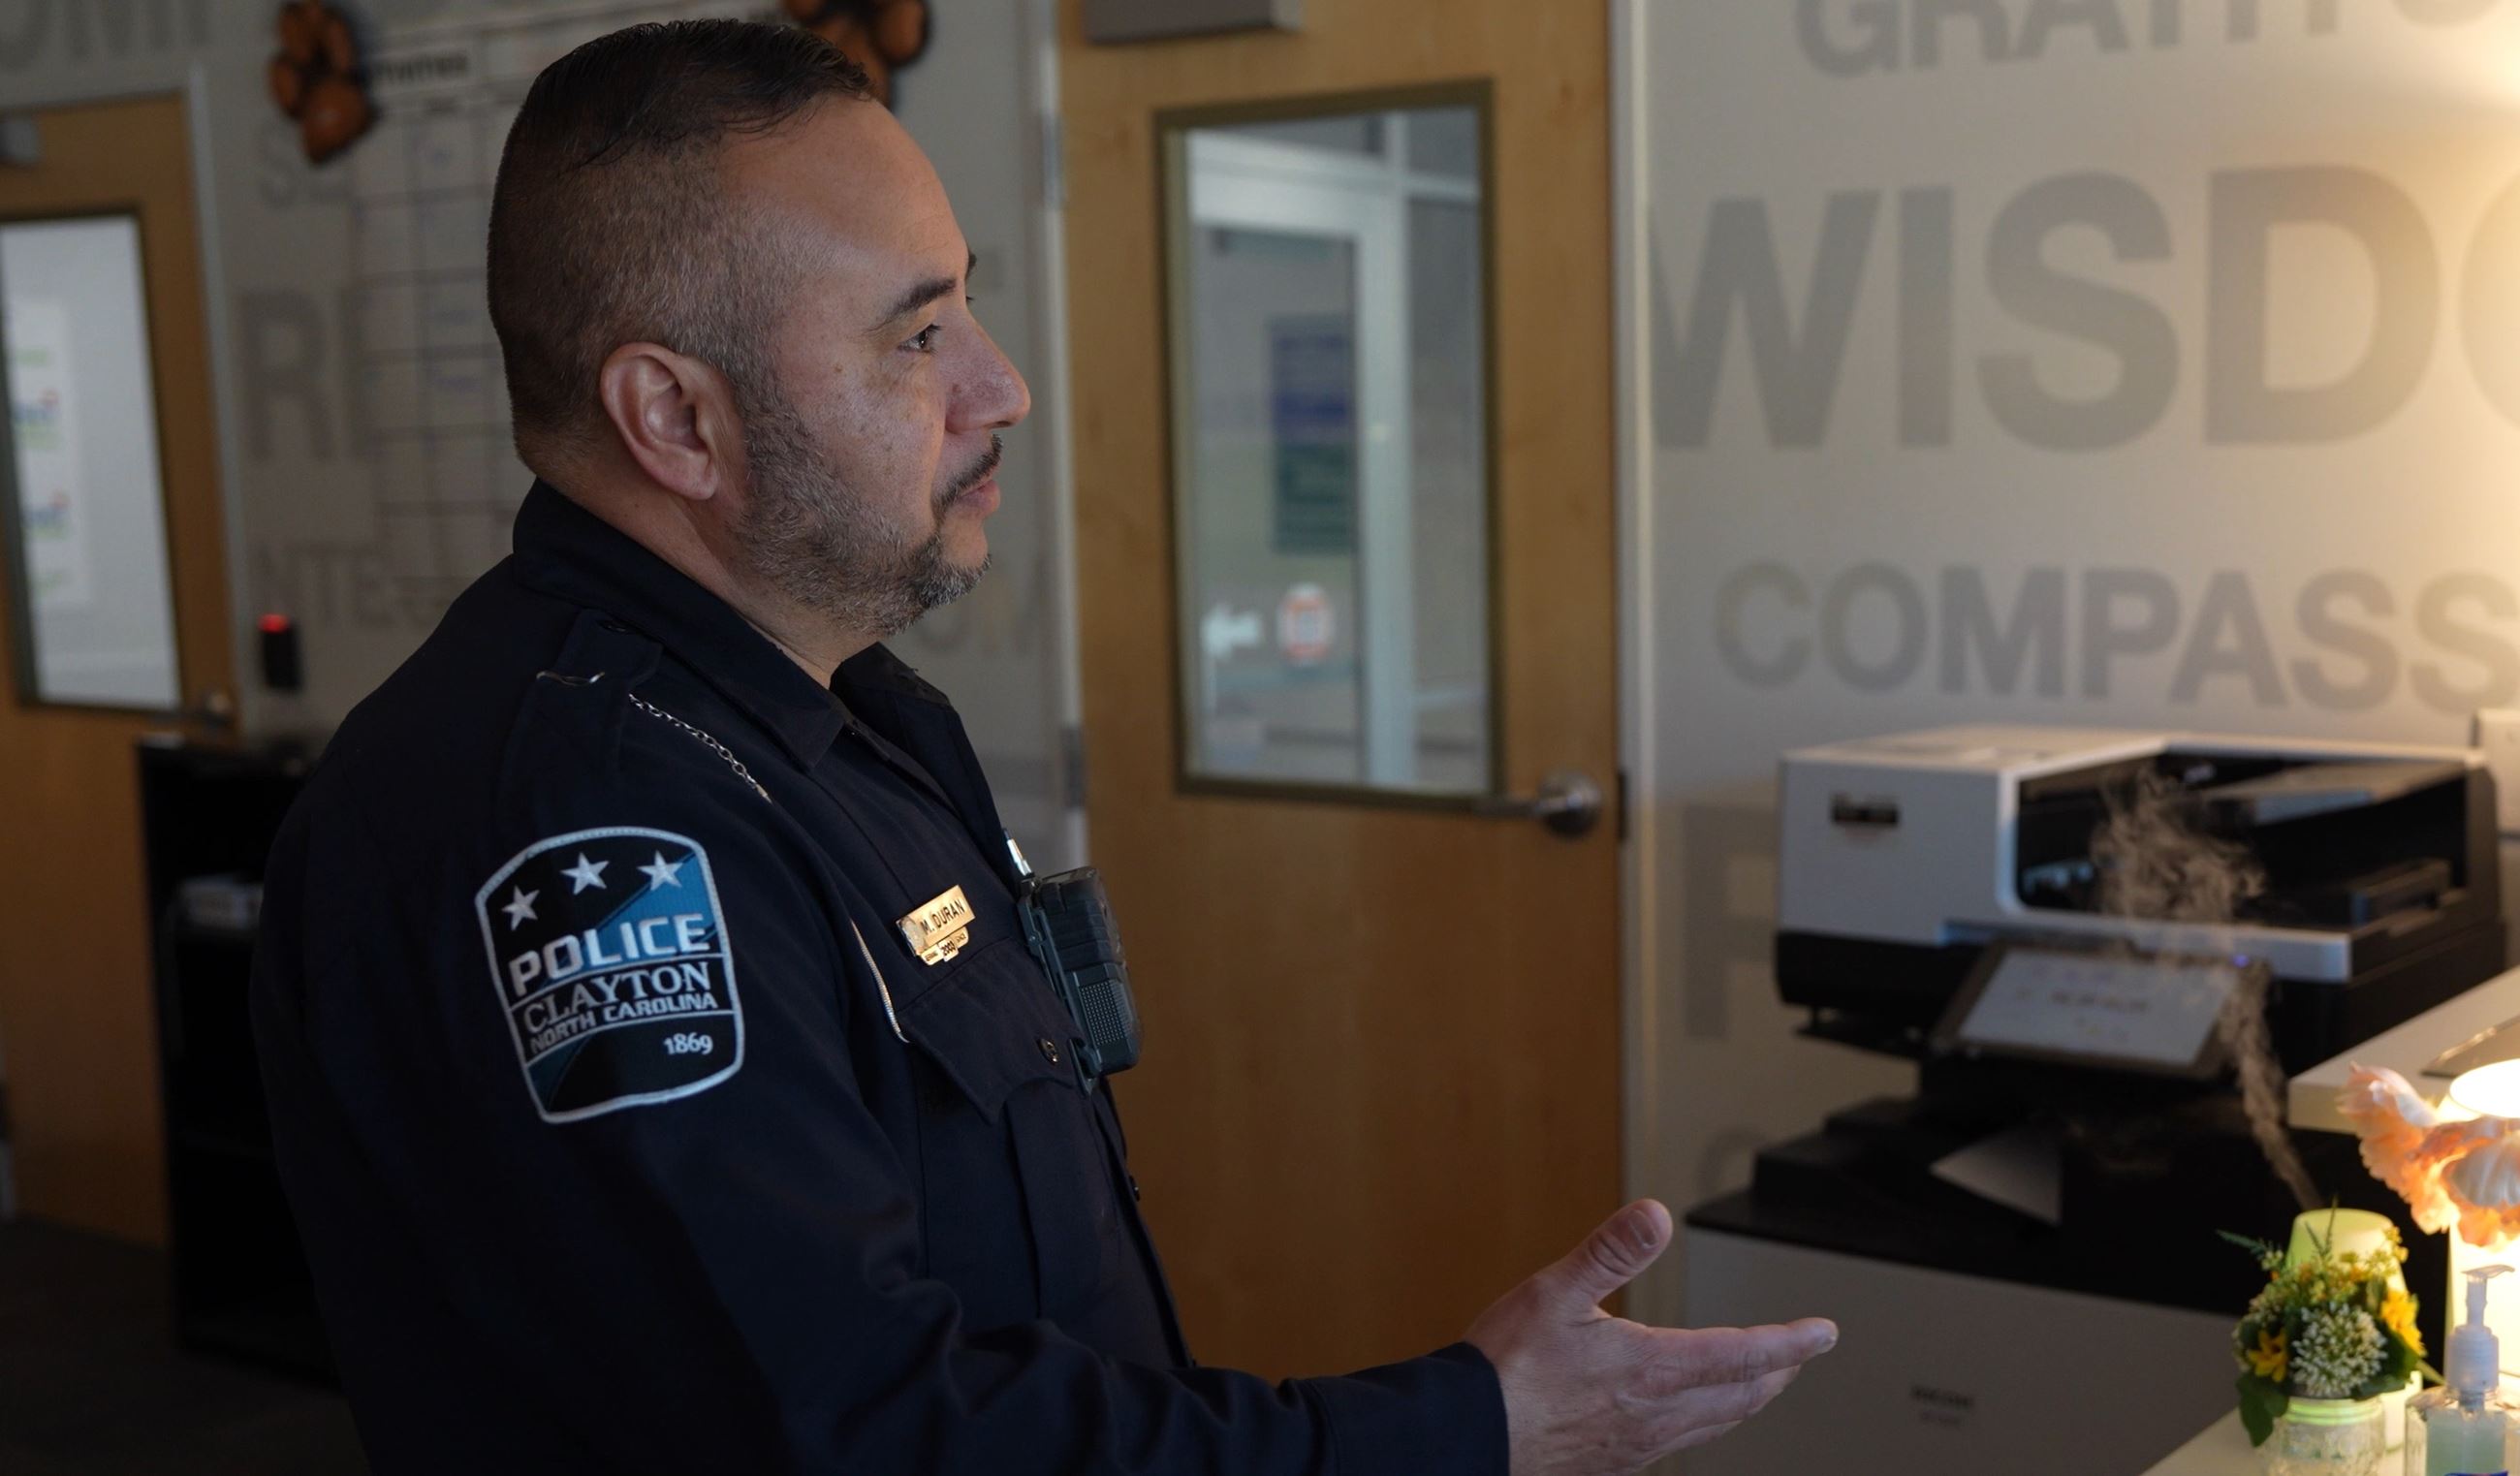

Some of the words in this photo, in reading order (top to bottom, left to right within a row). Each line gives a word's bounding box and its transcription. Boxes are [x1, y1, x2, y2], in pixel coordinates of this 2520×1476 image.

[1648, 163, 2520, 455] WISD
[1713, 559, 2520, 717] COMPASS
[932, 898, 965, 928] DURAN
[508, 913, 710, 998] POLICE
[523, 961, 712, 1035] CLAYTON
[529, 1009, 597, 1054] NORTH
[603, 990, 718, 1025] CAROLINA
[663, 1031, 714, 1056] 1869
